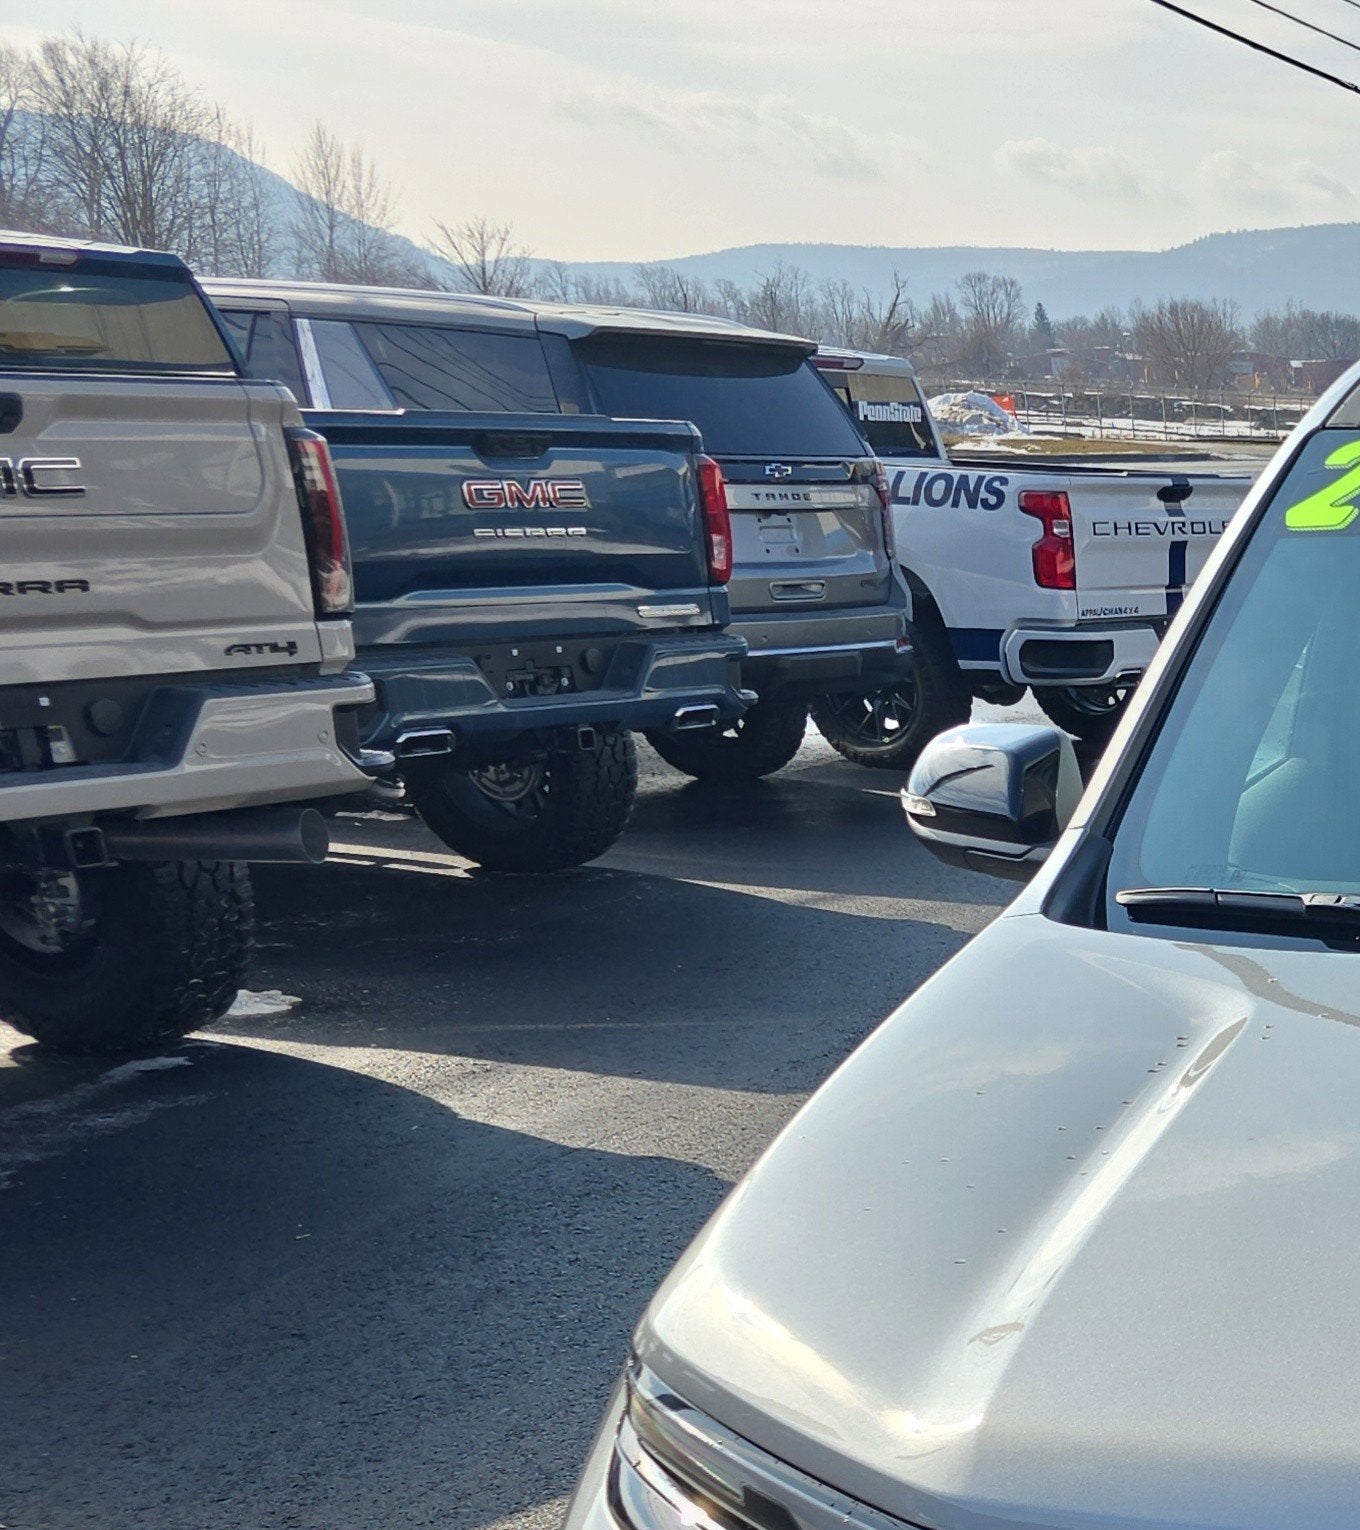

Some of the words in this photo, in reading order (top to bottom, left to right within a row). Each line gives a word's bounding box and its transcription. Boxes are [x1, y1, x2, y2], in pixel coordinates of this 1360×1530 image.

[462, 478, 588, 509] GMC
[750, 492, 812, 501] TAHOE
[890, 470, 1009, 510] LIONS
[223, 640, 298, 657] AT4
